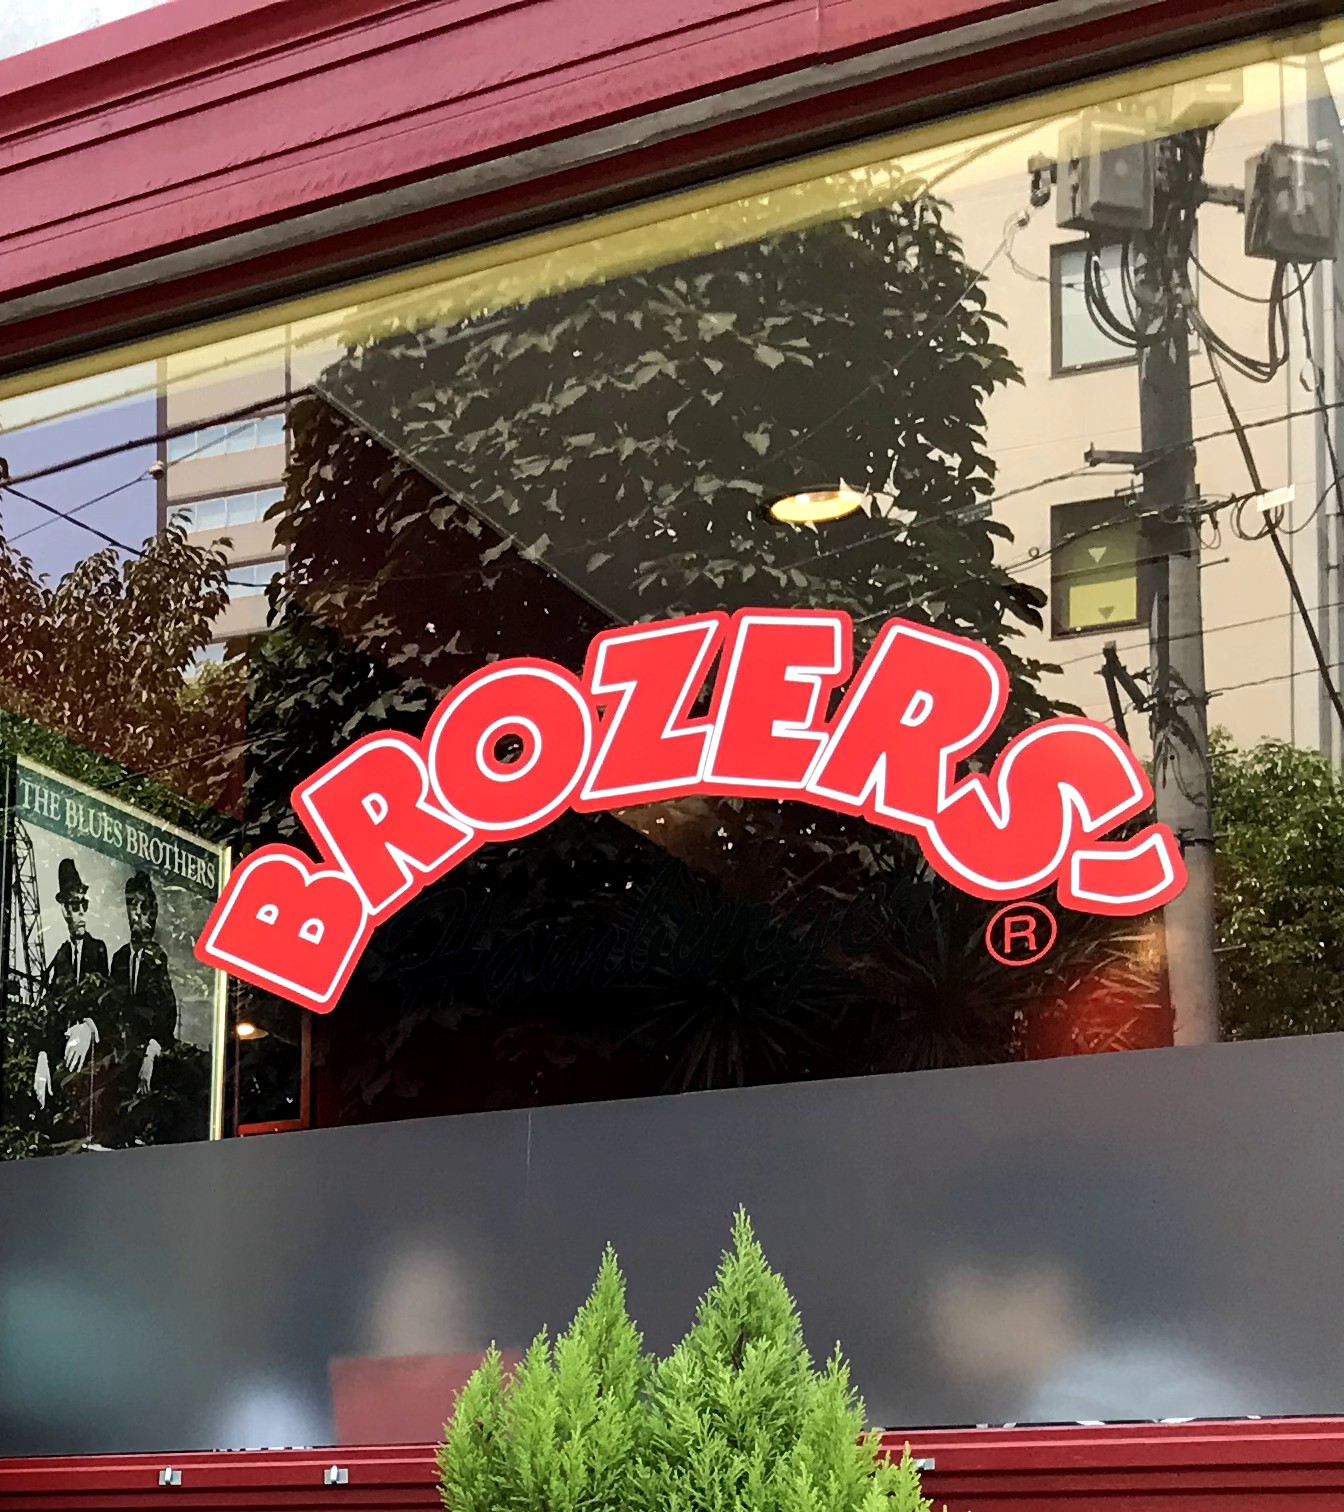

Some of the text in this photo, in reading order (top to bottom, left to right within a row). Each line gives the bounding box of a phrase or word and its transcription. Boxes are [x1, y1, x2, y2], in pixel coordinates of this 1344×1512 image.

[19, 779, 215, 889] THE BLUES BROTHERS
[194, 607, 1188, 1014] BROZERS'
